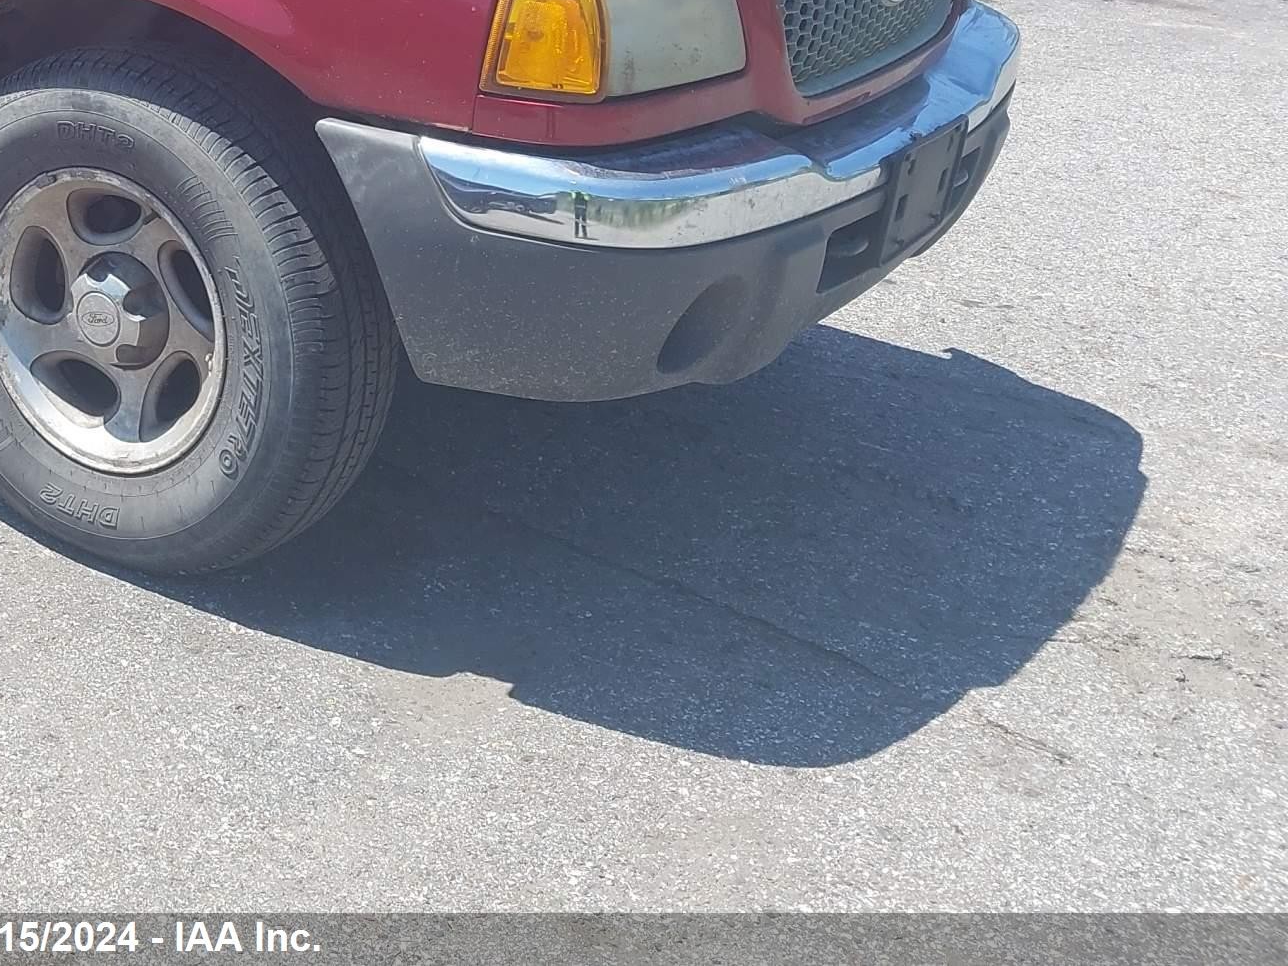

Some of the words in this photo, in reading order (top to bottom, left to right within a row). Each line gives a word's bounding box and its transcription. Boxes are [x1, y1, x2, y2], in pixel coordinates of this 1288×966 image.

[56, 120, 135, 150] DHT2
[86, 313, 109, 324] Ford
[39, 481, 121, 529] DHT2
